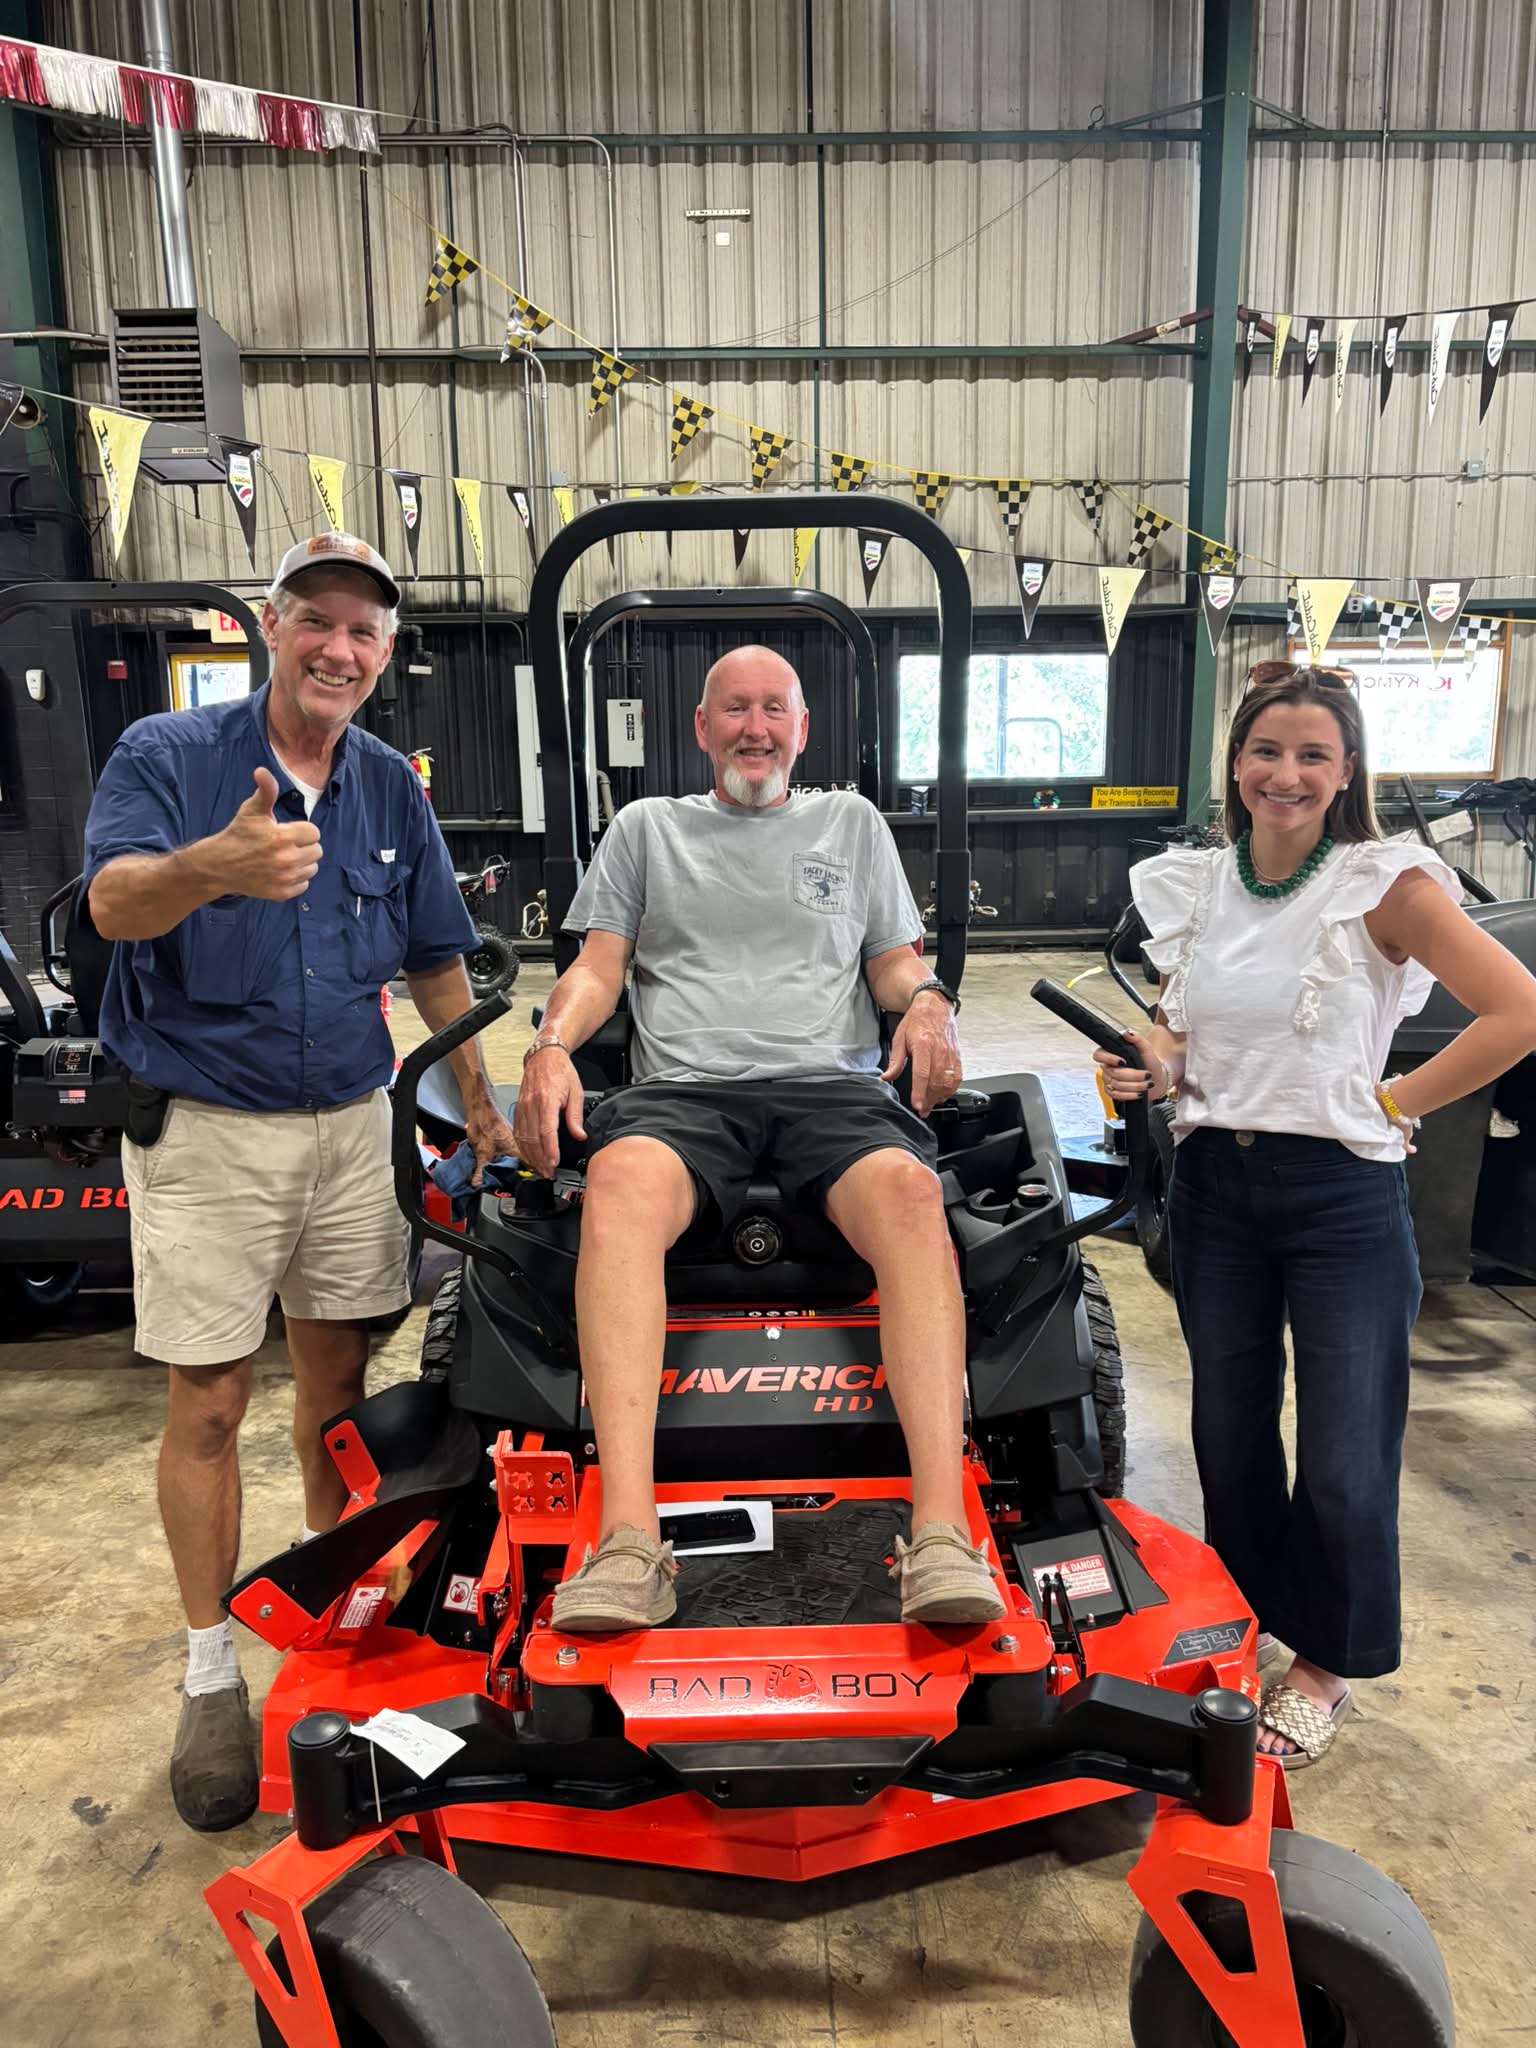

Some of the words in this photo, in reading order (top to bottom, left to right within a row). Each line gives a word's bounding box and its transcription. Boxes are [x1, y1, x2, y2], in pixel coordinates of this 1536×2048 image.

[1096, 788, 1109, 796] You
[1110, 788, 1122, 796] Are
[1123, 788, 1142, 798] Being
[1143, 788, 1175, 796] Recorded
[1109, 798, 1136, 807] Training
[1143, 798, 1170, 808] Security
[0, 1188, 64, 1209] AD
[80, 1187, 129, 1208] BO
[813, 1395, 874, 1412] HD
[1070, 1558, 1103, 1572] DANGER
[1176, 1628, 1241, 1657] 54
[649, 1676, 752, 1701] BAD
[831, 1671, 934, 1698] BOY
